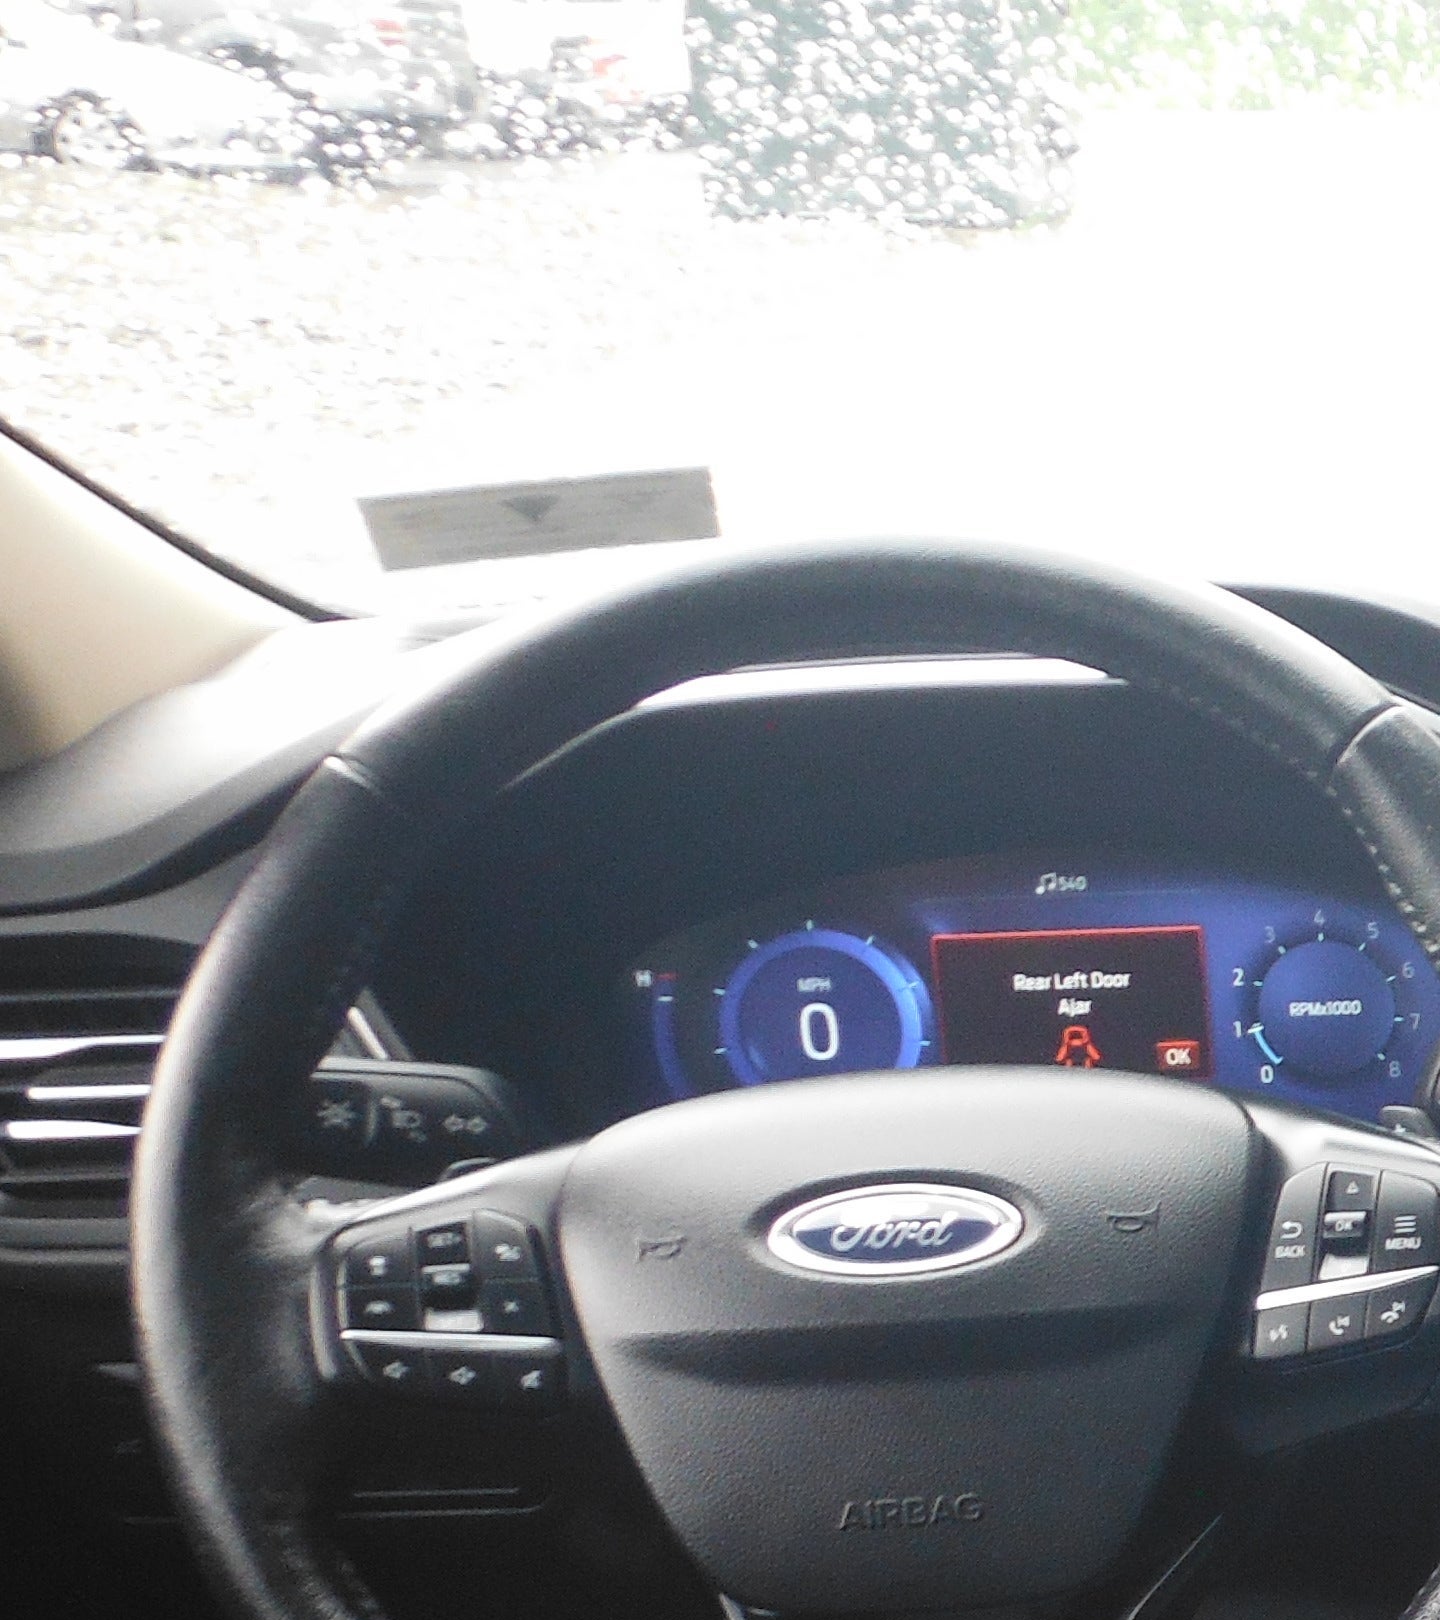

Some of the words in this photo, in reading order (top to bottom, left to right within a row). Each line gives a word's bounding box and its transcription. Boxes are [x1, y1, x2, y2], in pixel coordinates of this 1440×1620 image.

[1313, 909, 1325, 926] 4
[1264, 925, 1276, 943] 3
[1366, 921, 1380, 939] 5
[1232, 967, 1245, 987] 2
[1402, 961, 1415, 979] 6
[796, 976, 831, 992] MPH
[1012, 973, 1051, 991] Rear
[1053, 971, 1089, 990] Left
[1090, 970, 1132, 989] Door
[1057, 998, 1092, 1017] Ajar
[1289, 999, 1363, 1017] RPMx1000
[1232, 1020, 1242, 1038] 1
[1409, 1012, 1421, 1030] 7
[800, 1002, 839, 1060] 0
[1165, 1047, 1192, 1065] OK
[1260, 1064, 1274, 1084] 0
[1388, 1060, 1401, 1078] 8
[829, 1207, 960, 1253] Ford
[1274, 1244, 1306, 1259] BACK
[1384, 1236, 1422, 1250] MENU
[838, 1491, 985, 1530] AIRBAG
